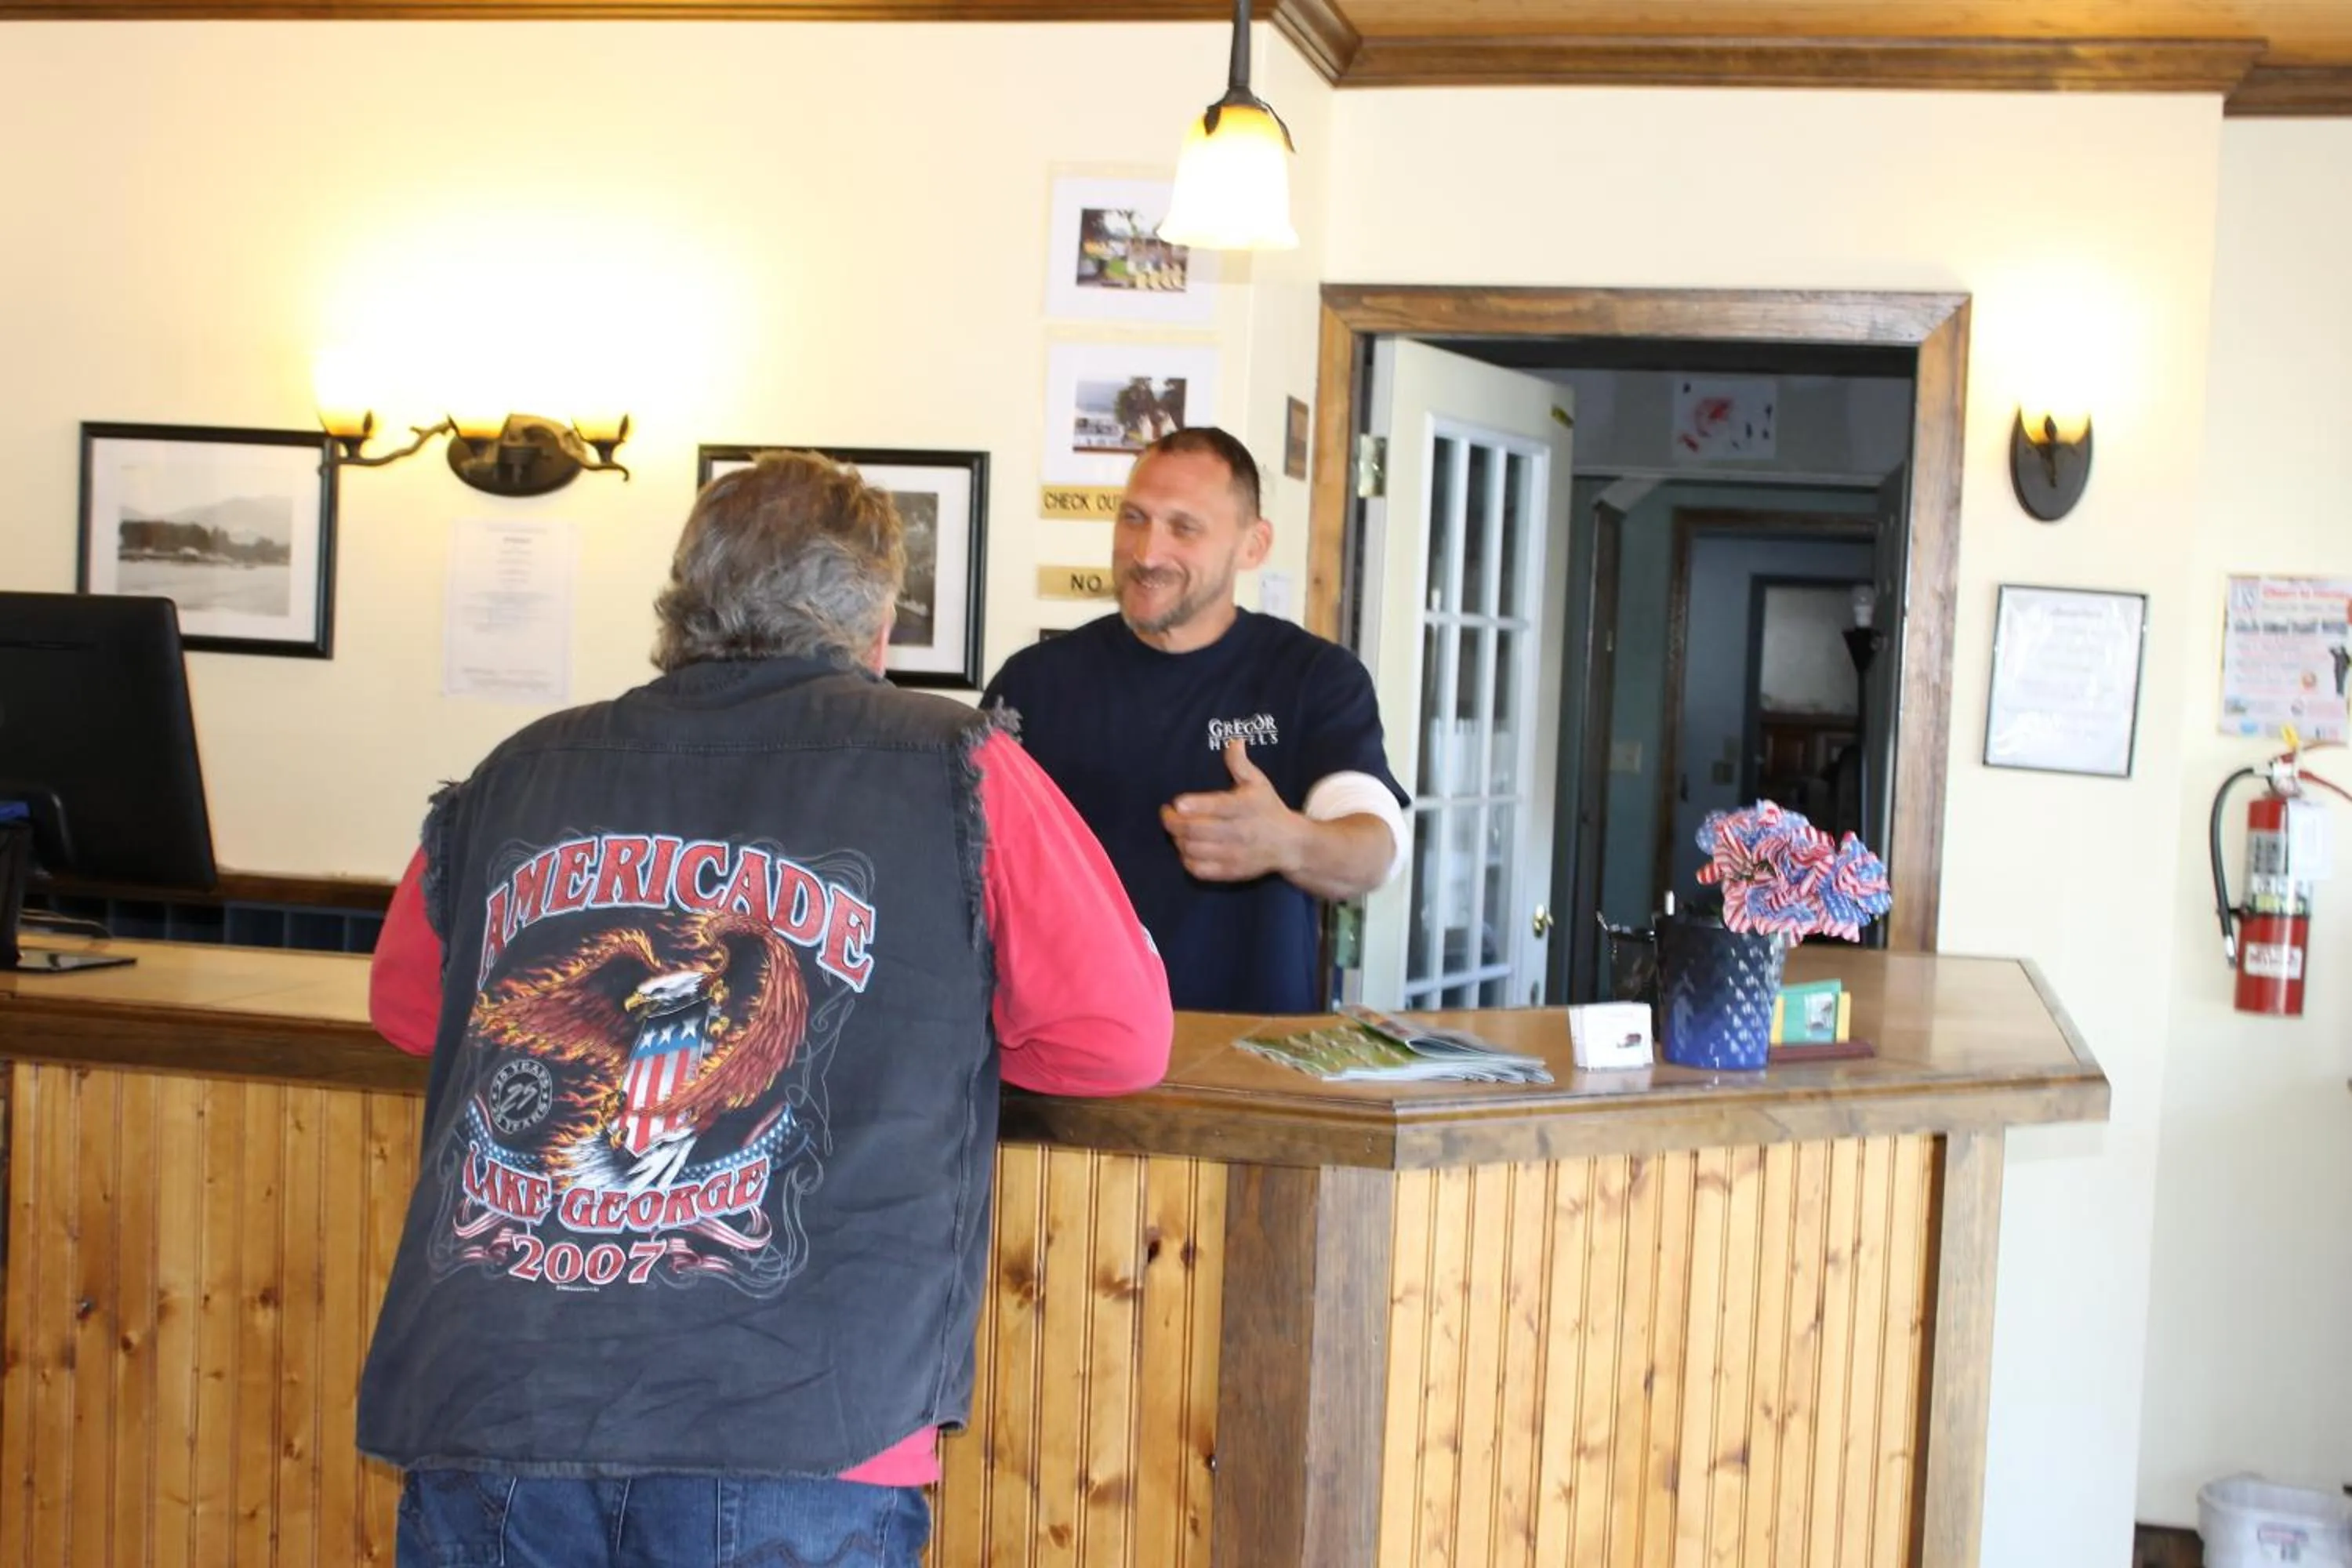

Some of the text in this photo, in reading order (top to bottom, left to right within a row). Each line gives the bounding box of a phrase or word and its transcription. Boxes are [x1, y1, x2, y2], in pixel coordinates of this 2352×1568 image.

[1044, 491, 1122, 512] CHECK OU
[1070, 573, 1102, 593] NO
[1208, 713, 1277, 737] GREGOR
[1208, 731, 1279, 750] HOELS
[477, 833, 876, 992] AMERICADE
[463, 1140, 771, 1234] LAKE GEORGE
[509, 1233, 666, 1284] 2007
